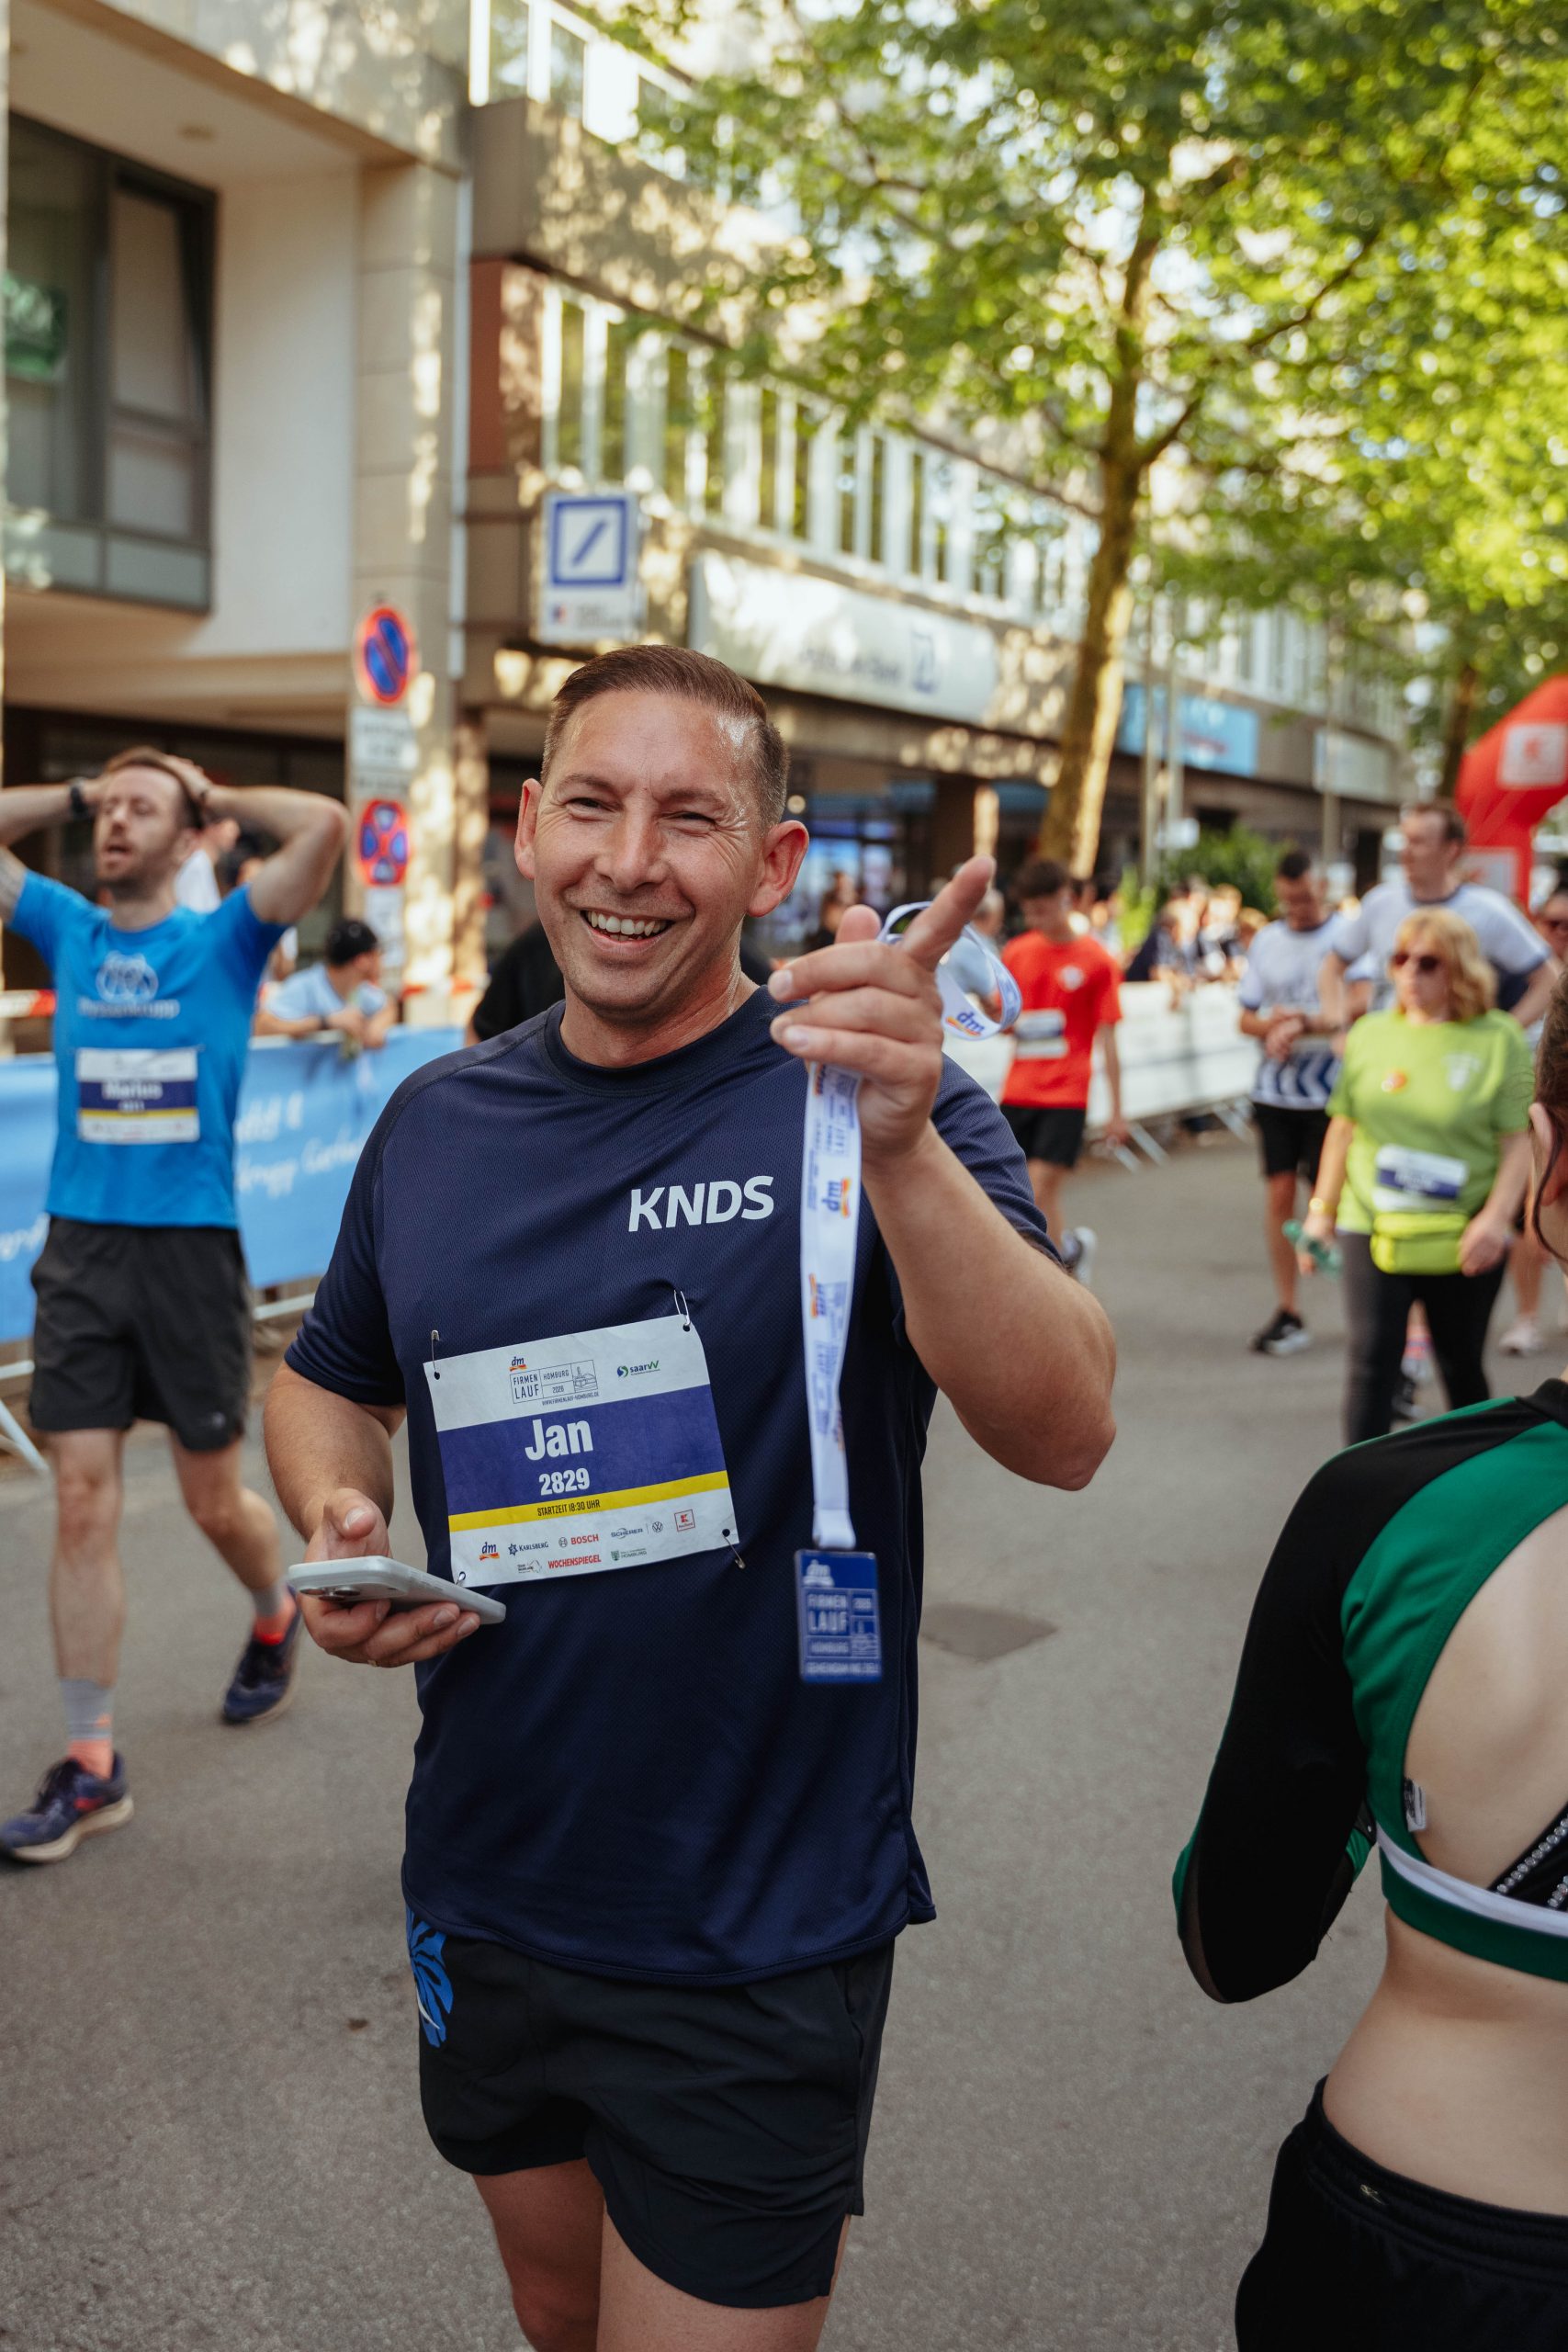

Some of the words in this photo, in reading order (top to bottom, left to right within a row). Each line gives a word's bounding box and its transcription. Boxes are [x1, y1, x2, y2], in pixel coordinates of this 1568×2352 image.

[956, 1011, 985, 1033] dm
[628, 1175, 774, 1232] KNDS
[822, 1181, 842, 1212] dm
[511, 1356, 525, 1366] dm
[513, 1374, 538, 1385] FIRMEN
[543, 1370, 570, 1380] HOMBURG
[514, 1384, 539, 1399] LAUF
[525, 1419, 593, 1461] Jan
[538, 1467, 591, 1496] 2829
[537, 1503, 567, 1517] STARTZEIT
[569, 1501, 585, 1512] 18:30
[587, 1499, 601, 1510] UHR
[570, 1534, 599, 1545] BOSCH
[611, 1528, 643, 1538] SCHERER
[481, 1542, 497, 1554] dm
[519, 1542, 549, 1552] KARLSBERG
[547, 1554, 602, 1569] WOCHENSPIEGEL
[808, 1611, 847, 1633] LAUF
